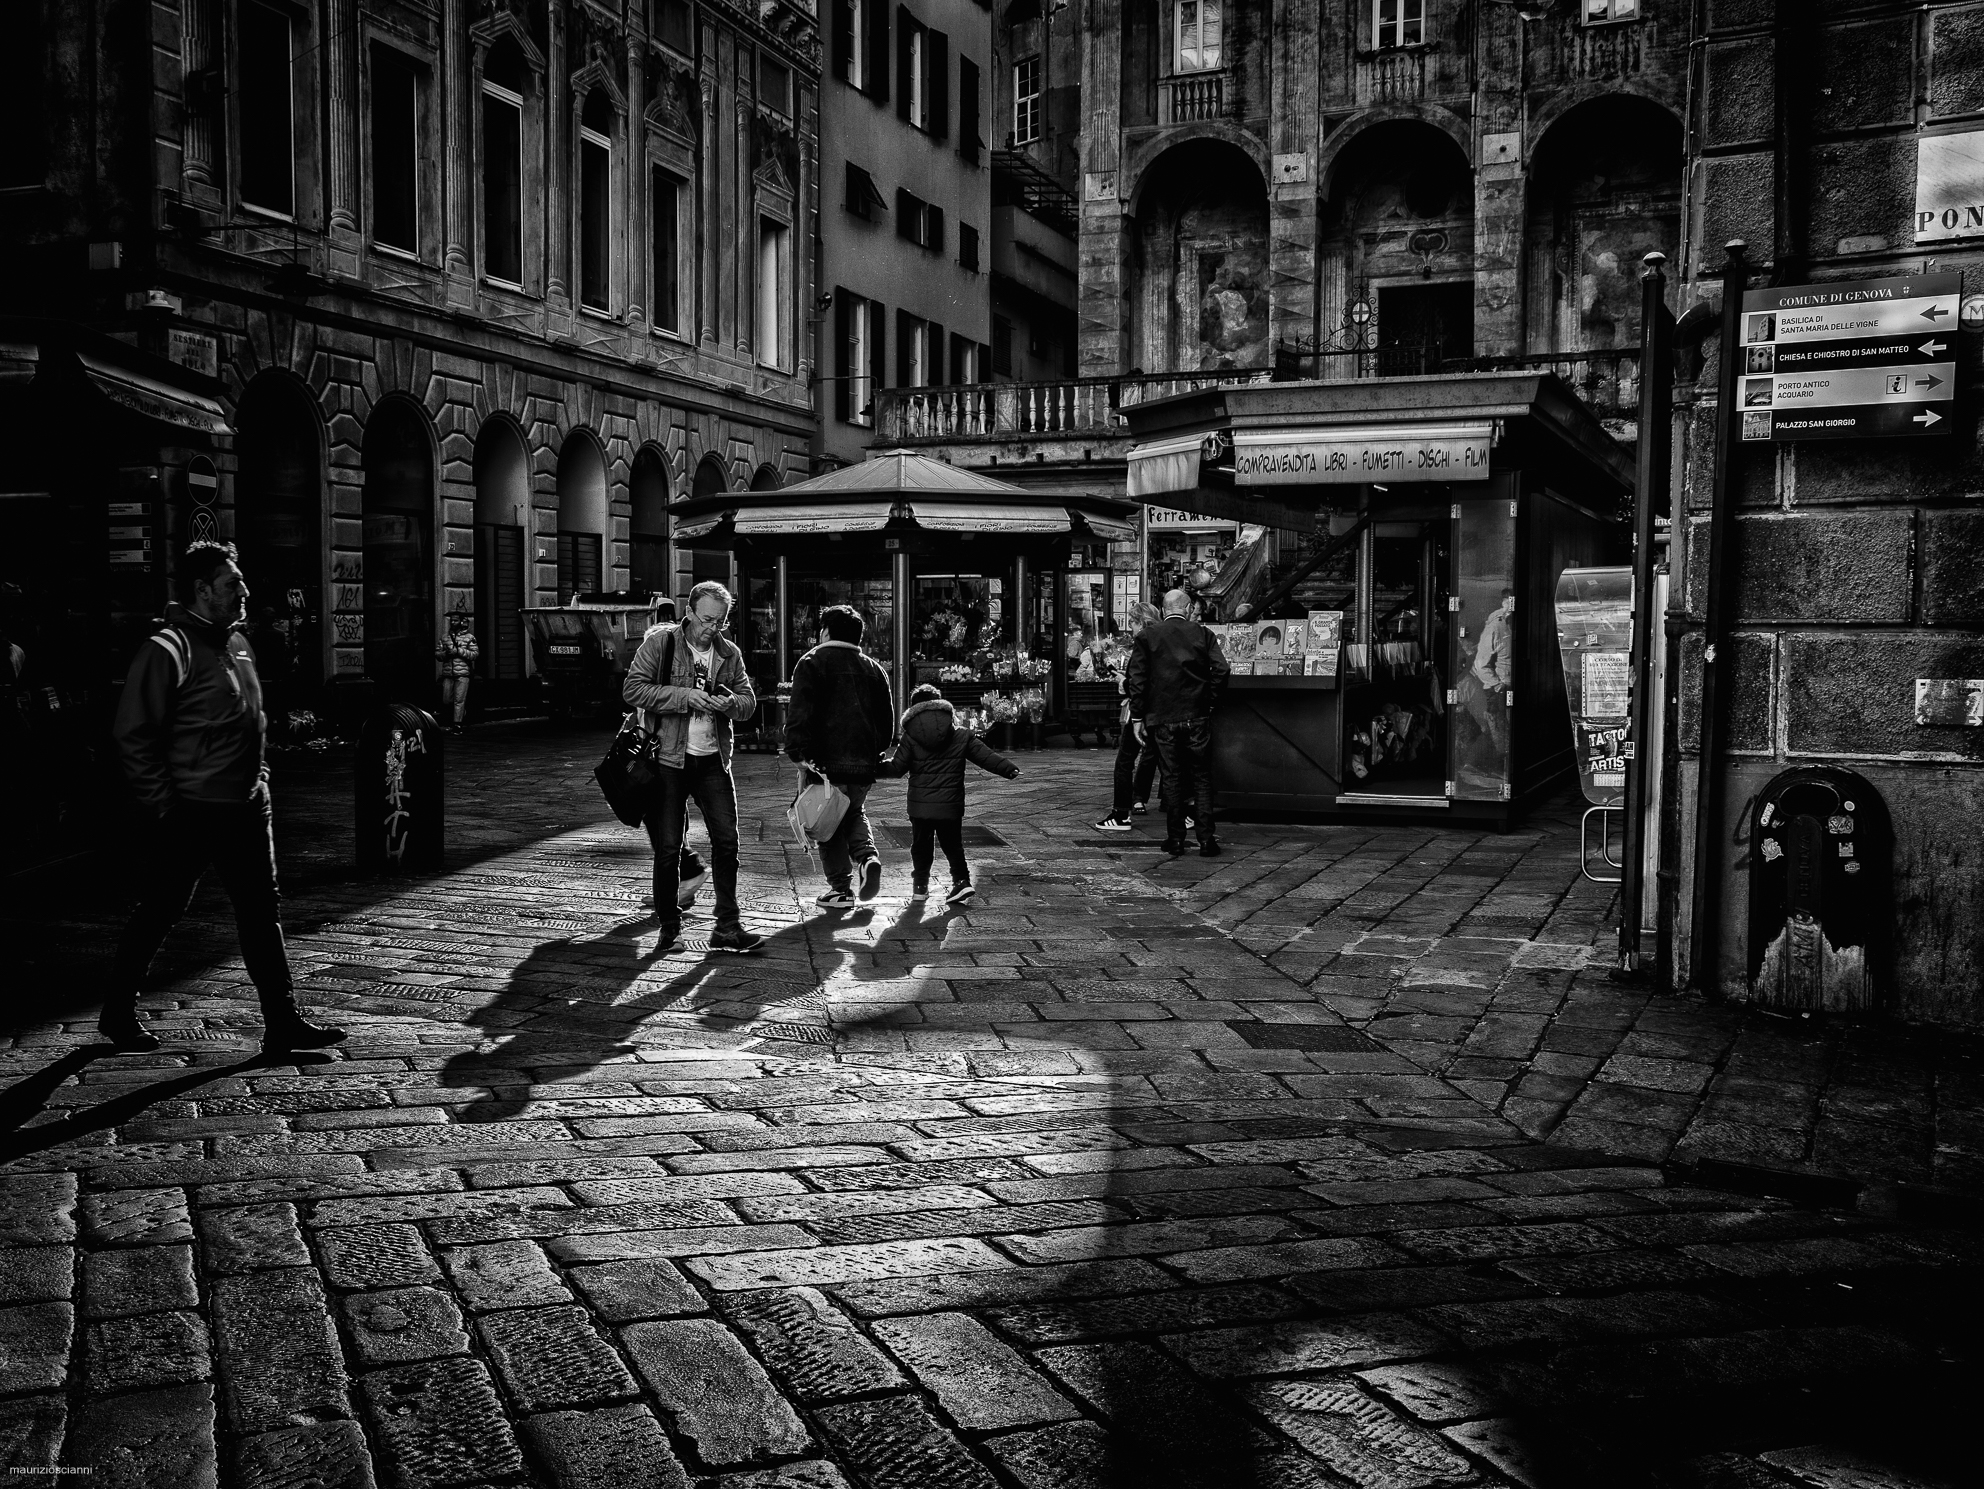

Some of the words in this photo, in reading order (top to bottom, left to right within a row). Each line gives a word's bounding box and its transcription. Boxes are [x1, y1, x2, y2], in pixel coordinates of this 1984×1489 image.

[1779, 296, 1828, 307] COMUNE
[1830, 293, 1843, 302] DI
[1845, 289, 1893, 301] GENOVA
[1780, 325, 1804, 334] SANTA
[1806, 324, 1829, 332] MARIA
[1831, 322, 1855, 330] DELLE
[1856, 320, 1879, 328] VIGNE
[1781, 317, 1814, 325] BASILICA
[173, 334, 213, 349] SESTIERE
[186, 348, 200, 357] DEL
[1779, 352, 1806, 362] CHIESA
[1807, 352, 1813, 360] E
[1813, 349, 1851, 359] CHIOSTRO
[1852, 348, 1860, 357] DI
[1861, 347, 1878, 356] SAN
[1880, 345, 1910, 355] MATTEO
[181, 358, 206, 371] MOLO
[1778, 382, 1802, 390] PORTO
[1803, 380, 1830, 389] ANTICO
[1777, 390, 1814, 399] ACQUARIO
[1775, 420, 1808, 429] PALAZZO
[1808, 420, 1824, 428] SAN
[1825, 418, 1856, 427] GIORGIO
[1237, 453, 1316, 475] COMPRAVENDITA
[1324, 452, 1348, 471] LIBRI
[1362, 450, 1404, 471] FUMETTI
[1418, 448, 1450, 469] DISCHI
[1465, 447, 1487, 468] FILM
